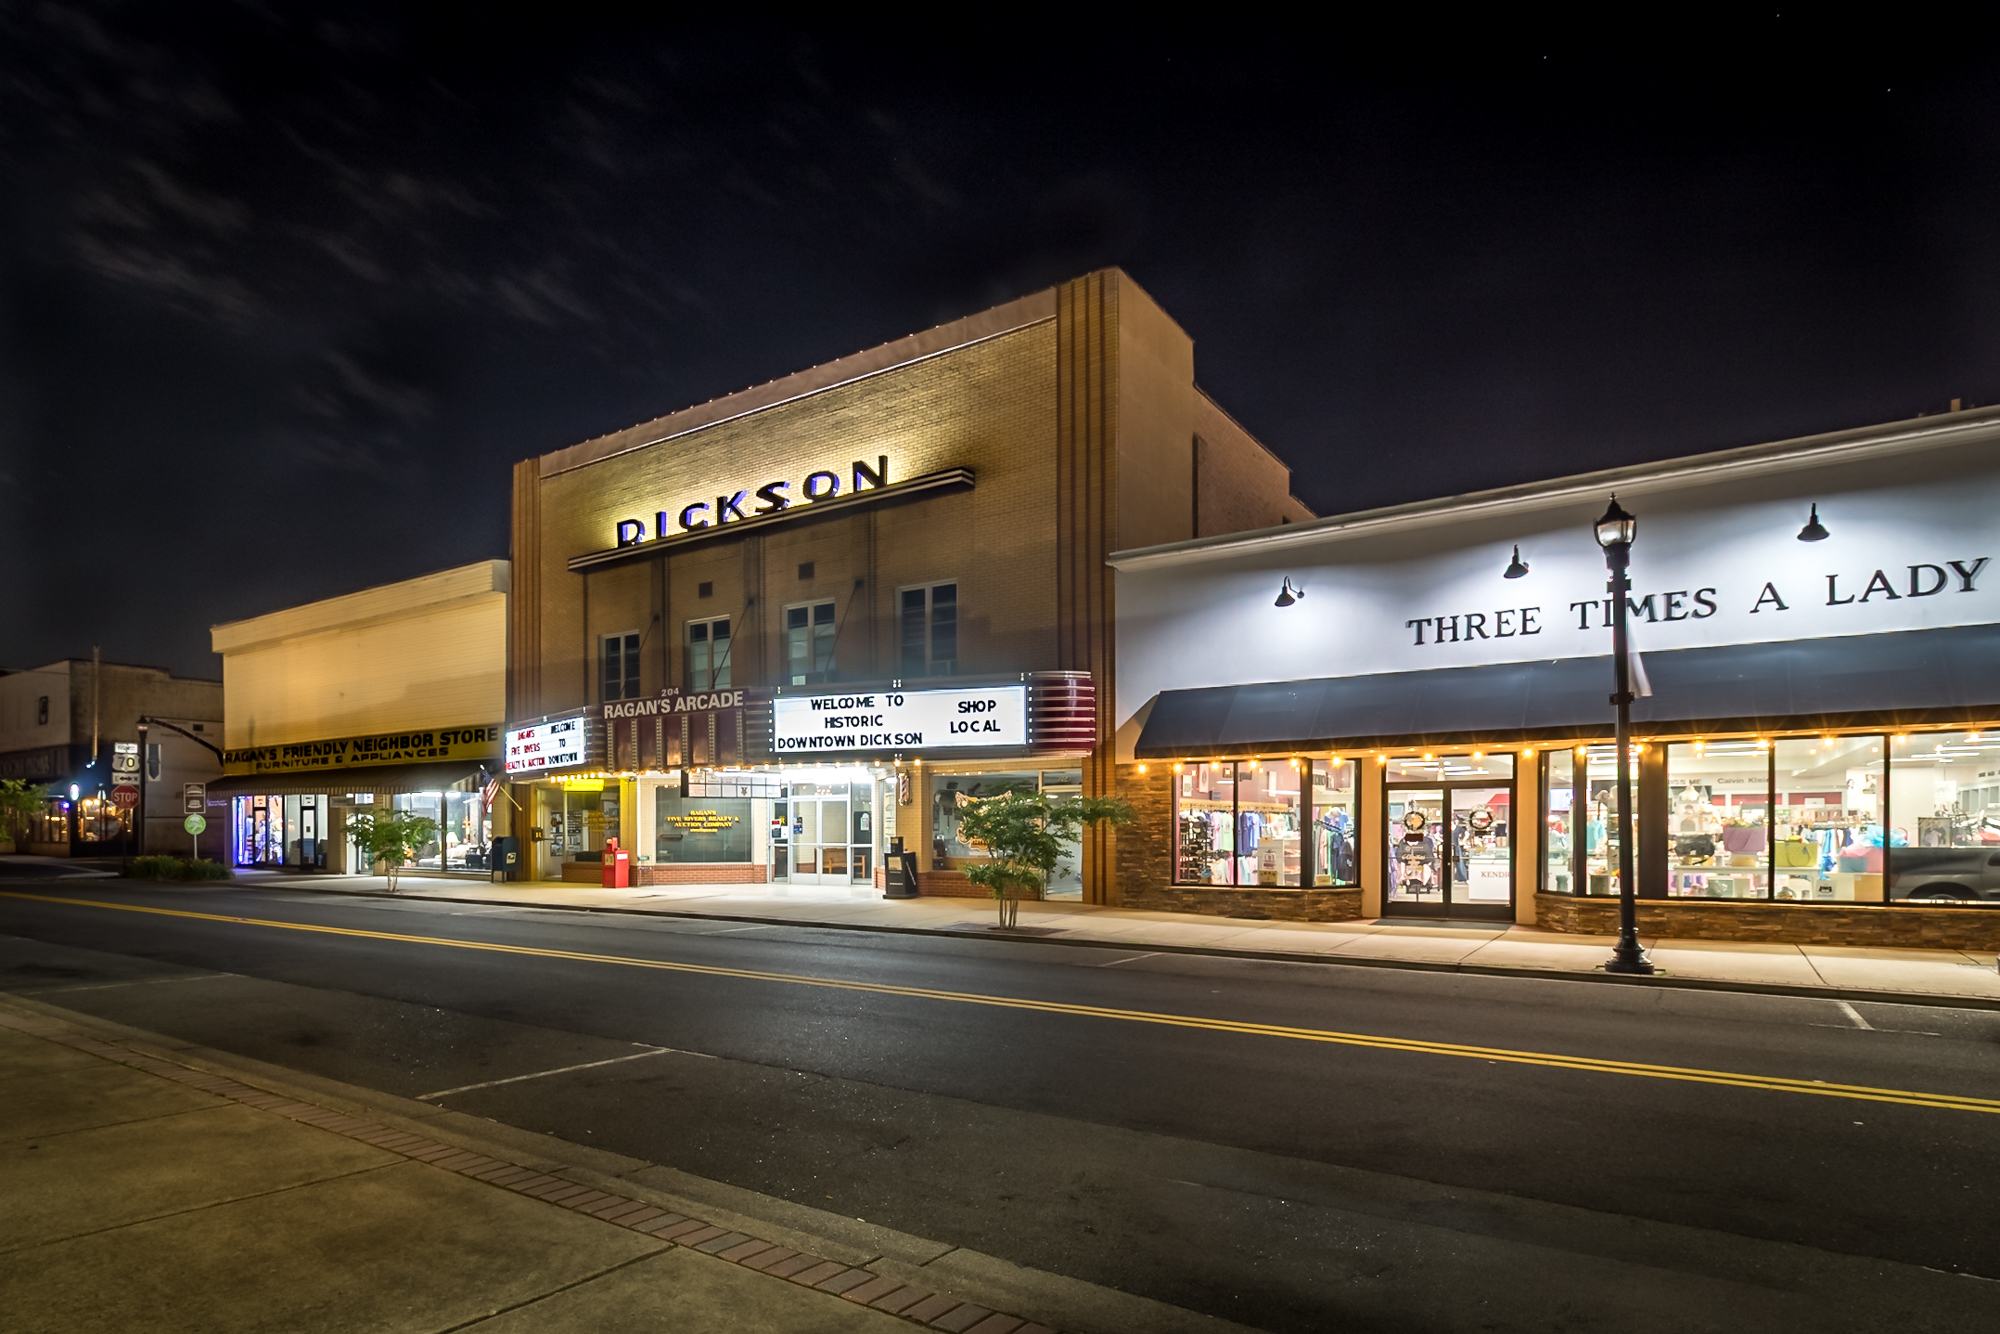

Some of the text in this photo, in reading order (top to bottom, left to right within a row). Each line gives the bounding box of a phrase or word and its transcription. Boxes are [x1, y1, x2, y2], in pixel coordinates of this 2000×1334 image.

[616, 455, 888, 548] DICKSON
[1405, 557, 1990, 646] THREE TIMES A LADY
[661, 687, 679, 697] 204
[604, 691, 744, 719] RAGAN'S ARCADE
[810, 695, 904, 710] WELCOME TO
[957, 700, 996, 713] SHOP
[550, 721, 576, 734] WELCOME
[824, 715, 883, 728] HISTORIC
[950, 719, 1001, 733] LOCAL
[225, 727, 498, 764] RAGAN'S FRIENDLY NEIGHBOR STORE
[558, 738, 566, 748] TO
[777, 732, 923, 748] DOWNTOWN DICKSON
[117, 756, 135, 769] 70
[256, 757, 329, 770] FURNITURE
[351, 747, 449, 762] APPLIANCES
[528, 757, 546, 767] AUCTION
[548, 752, 578, 765] DOWNTOWN
[114, 792, 138, 802] STOP
